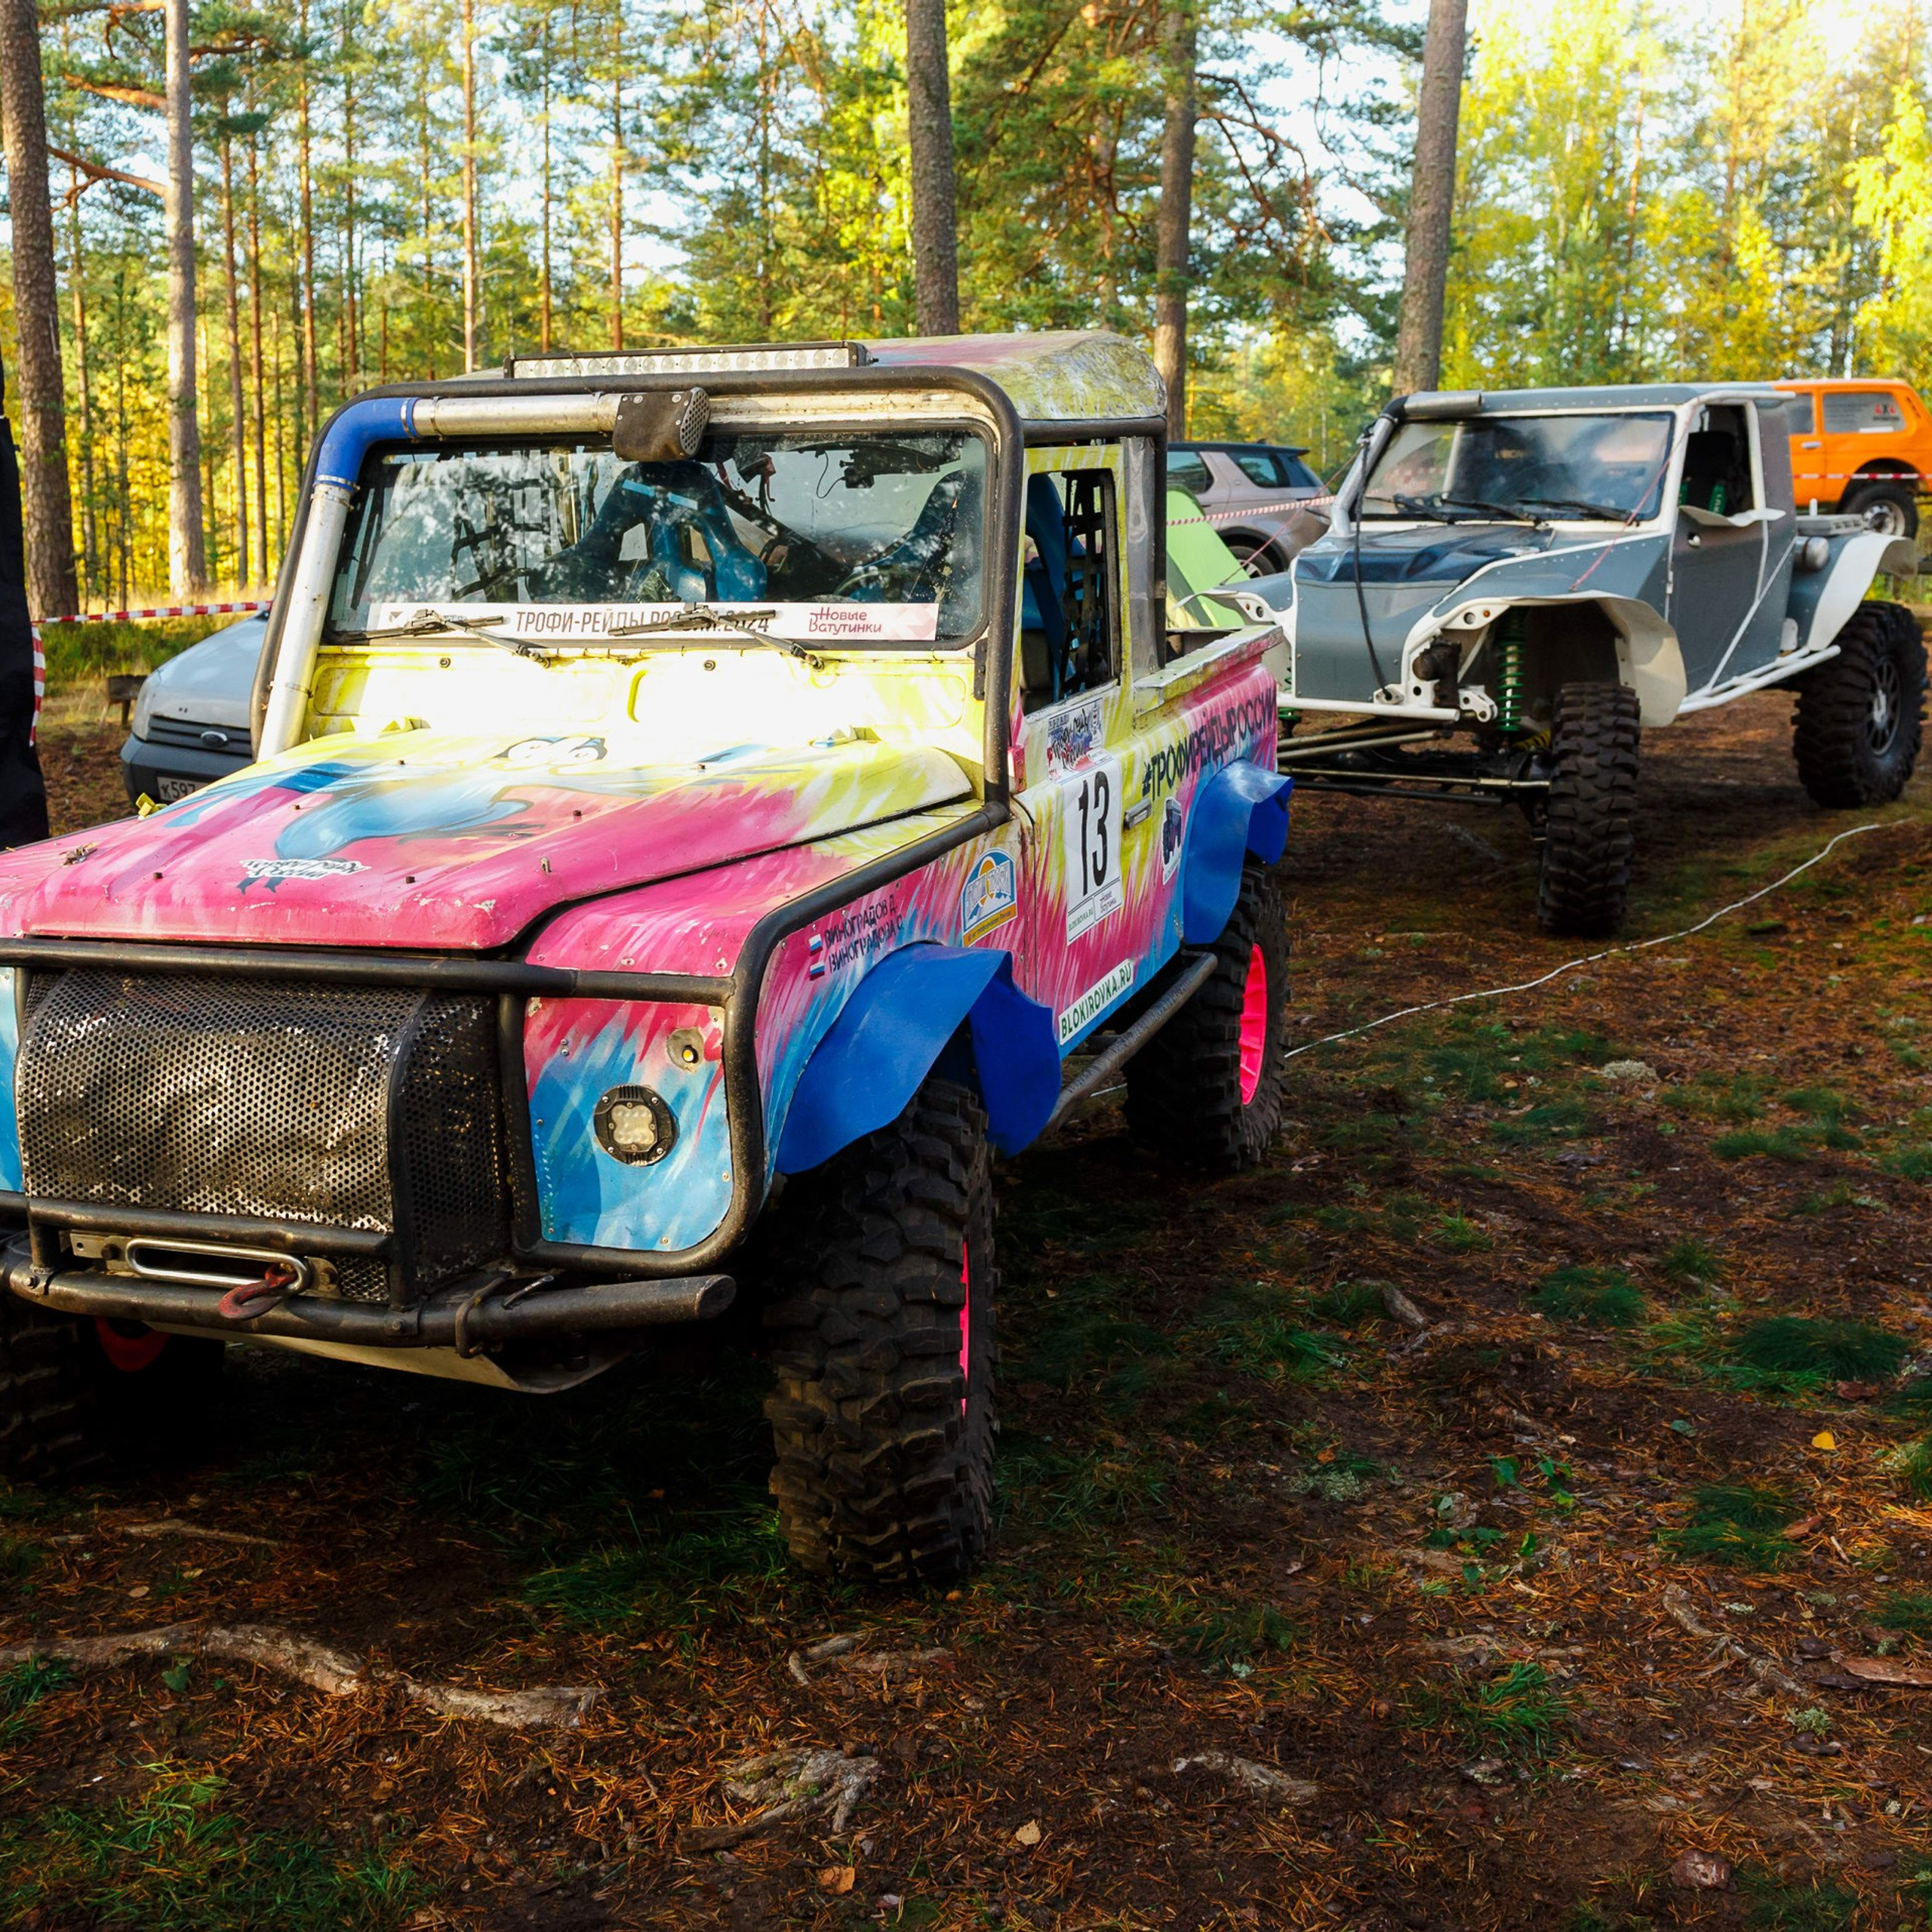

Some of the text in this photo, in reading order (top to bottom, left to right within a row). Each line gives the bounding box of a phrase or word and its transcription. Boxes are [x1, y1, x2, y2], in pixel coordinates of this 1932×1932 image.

[808, 616, 881, 635] Ватутинки
[810, 607, 867, 620] Новые
[1078, 771, 1109, 897] 13
[824, 899, 888, 950] ВИНОГРАДОВ
[1061, 962, 1132, 1039] BLOKIROVKA.RU
